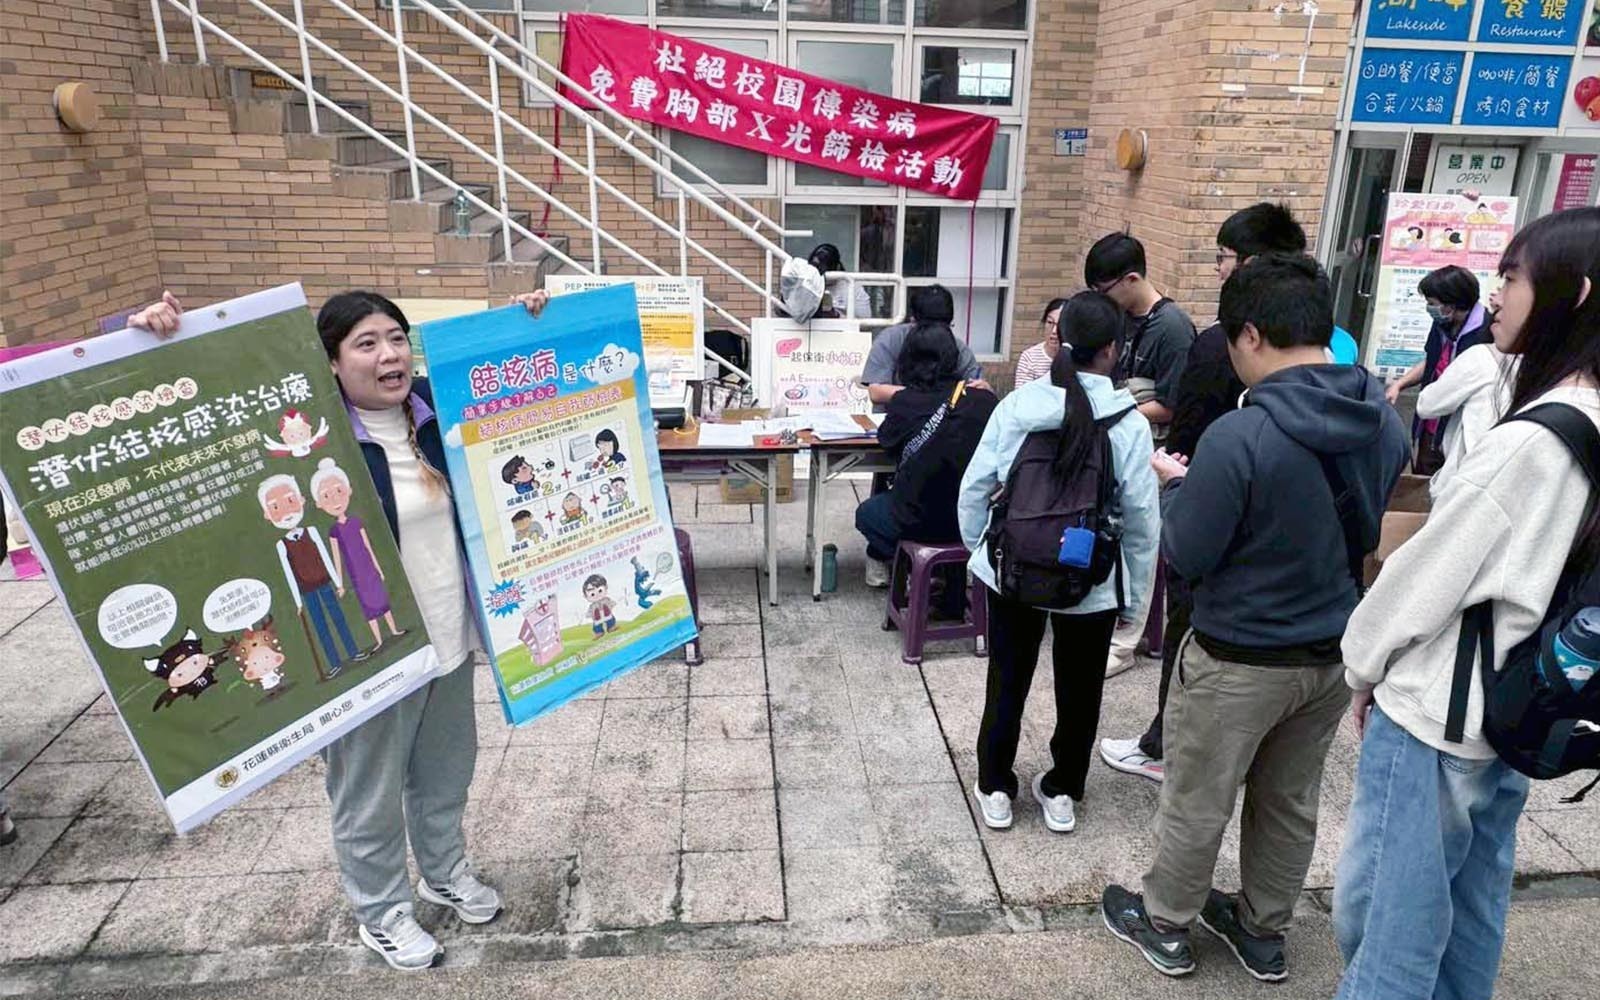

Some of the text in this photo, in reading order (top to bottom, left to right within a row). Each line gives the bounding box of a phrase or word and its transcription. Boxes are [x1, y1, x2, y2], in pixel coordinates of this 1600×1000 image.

[1386, 16, 1567, 40] Lakeside Restaurant
[653, 40, 918, 140] 杜絕校園傳染病
[1365, 91, 1444, 115] 合菜/火鍋
[1475, 96, 1551, 119] 烤肉食材
[588, 64, 964, 190] 免費胸部X光篩檢活動
[1448, 154, 1506, 170] 營業中
[1456, 172, 1492, 184] OPEN
[470, 350, 625, 397] 結核病 是什麼?
[20, 379, 196, 449] 潛伏結核感染檢查
[27, 371, 313, 494] 潛伏結核感染治療
[44, 428, 262, 519] 現在沒發病，不代表未來不發病
[242, 722, 315, 772] 花蓮縣衛生局
